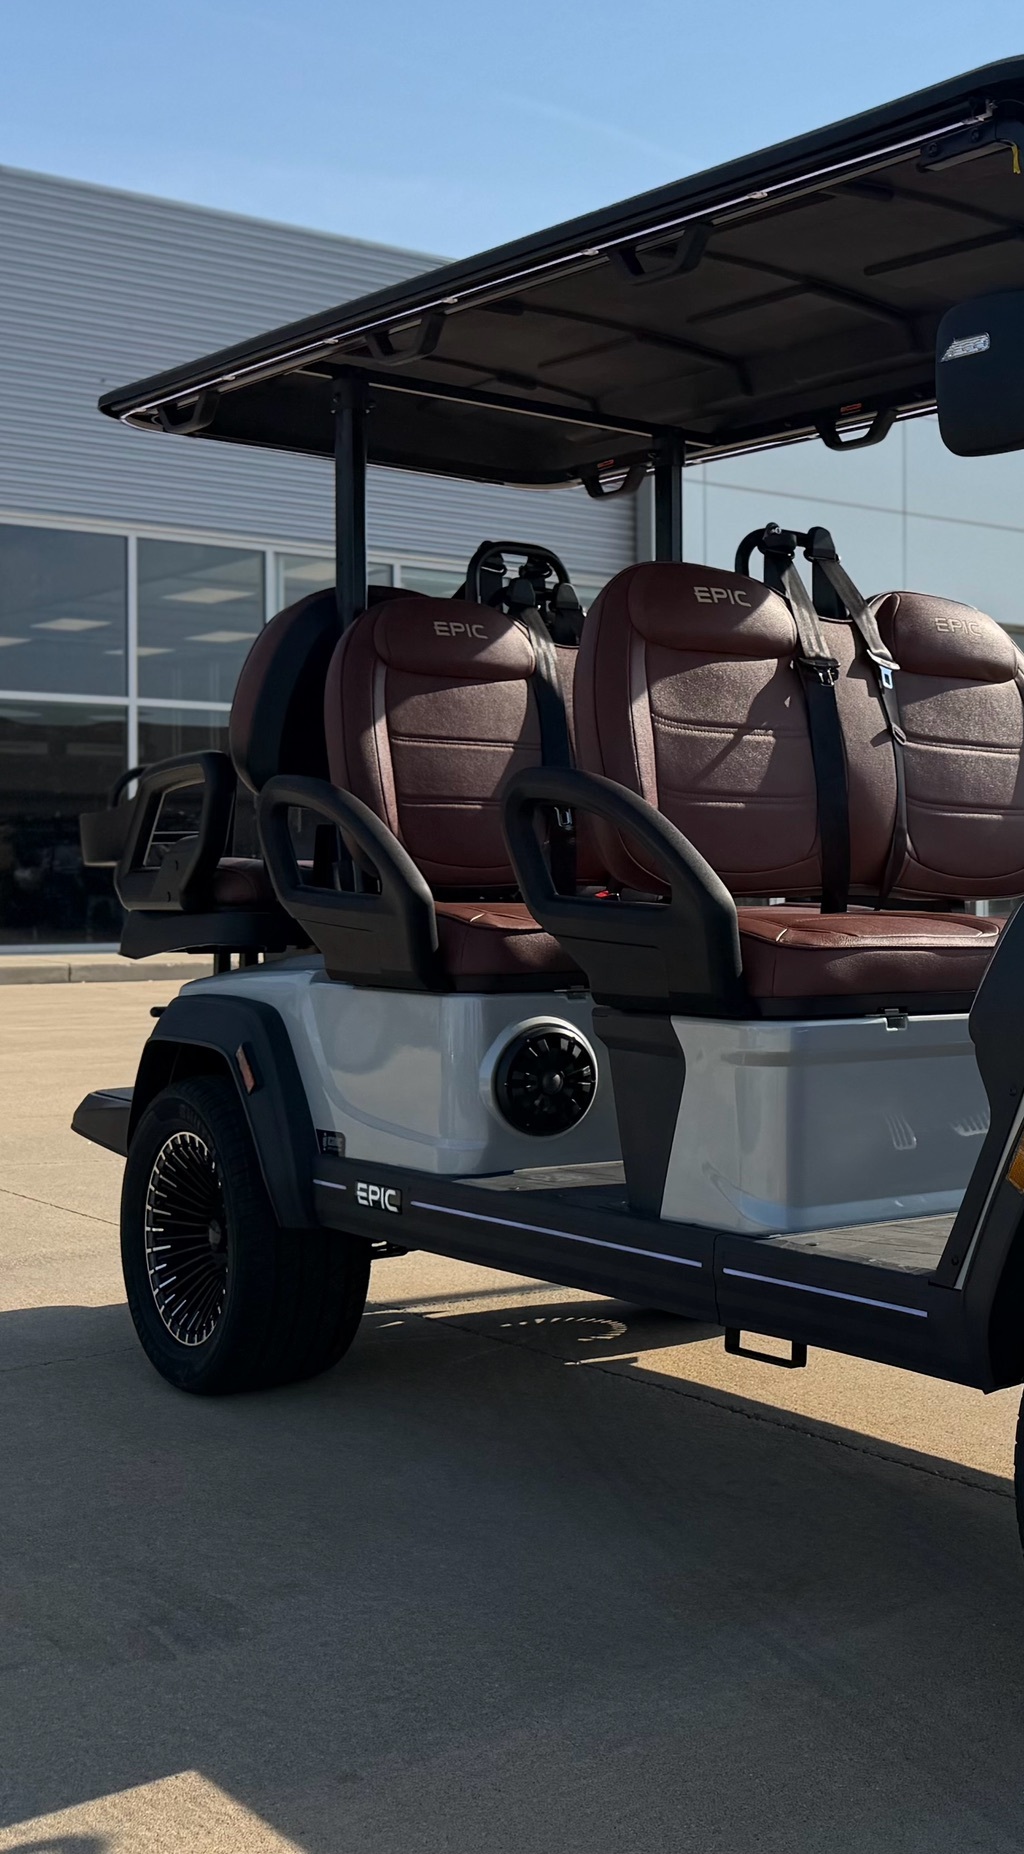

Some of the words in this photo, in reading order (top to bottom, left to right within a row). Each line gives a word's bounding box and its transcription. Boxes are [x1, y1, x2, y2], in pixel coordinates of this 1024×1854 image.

[693, 586, 752, 608] EPIC
[433, 620, 489, 640] EPIC
[933, 617, 984, 638] EPIC
[356, 1182, 399, 1214] EPIC
